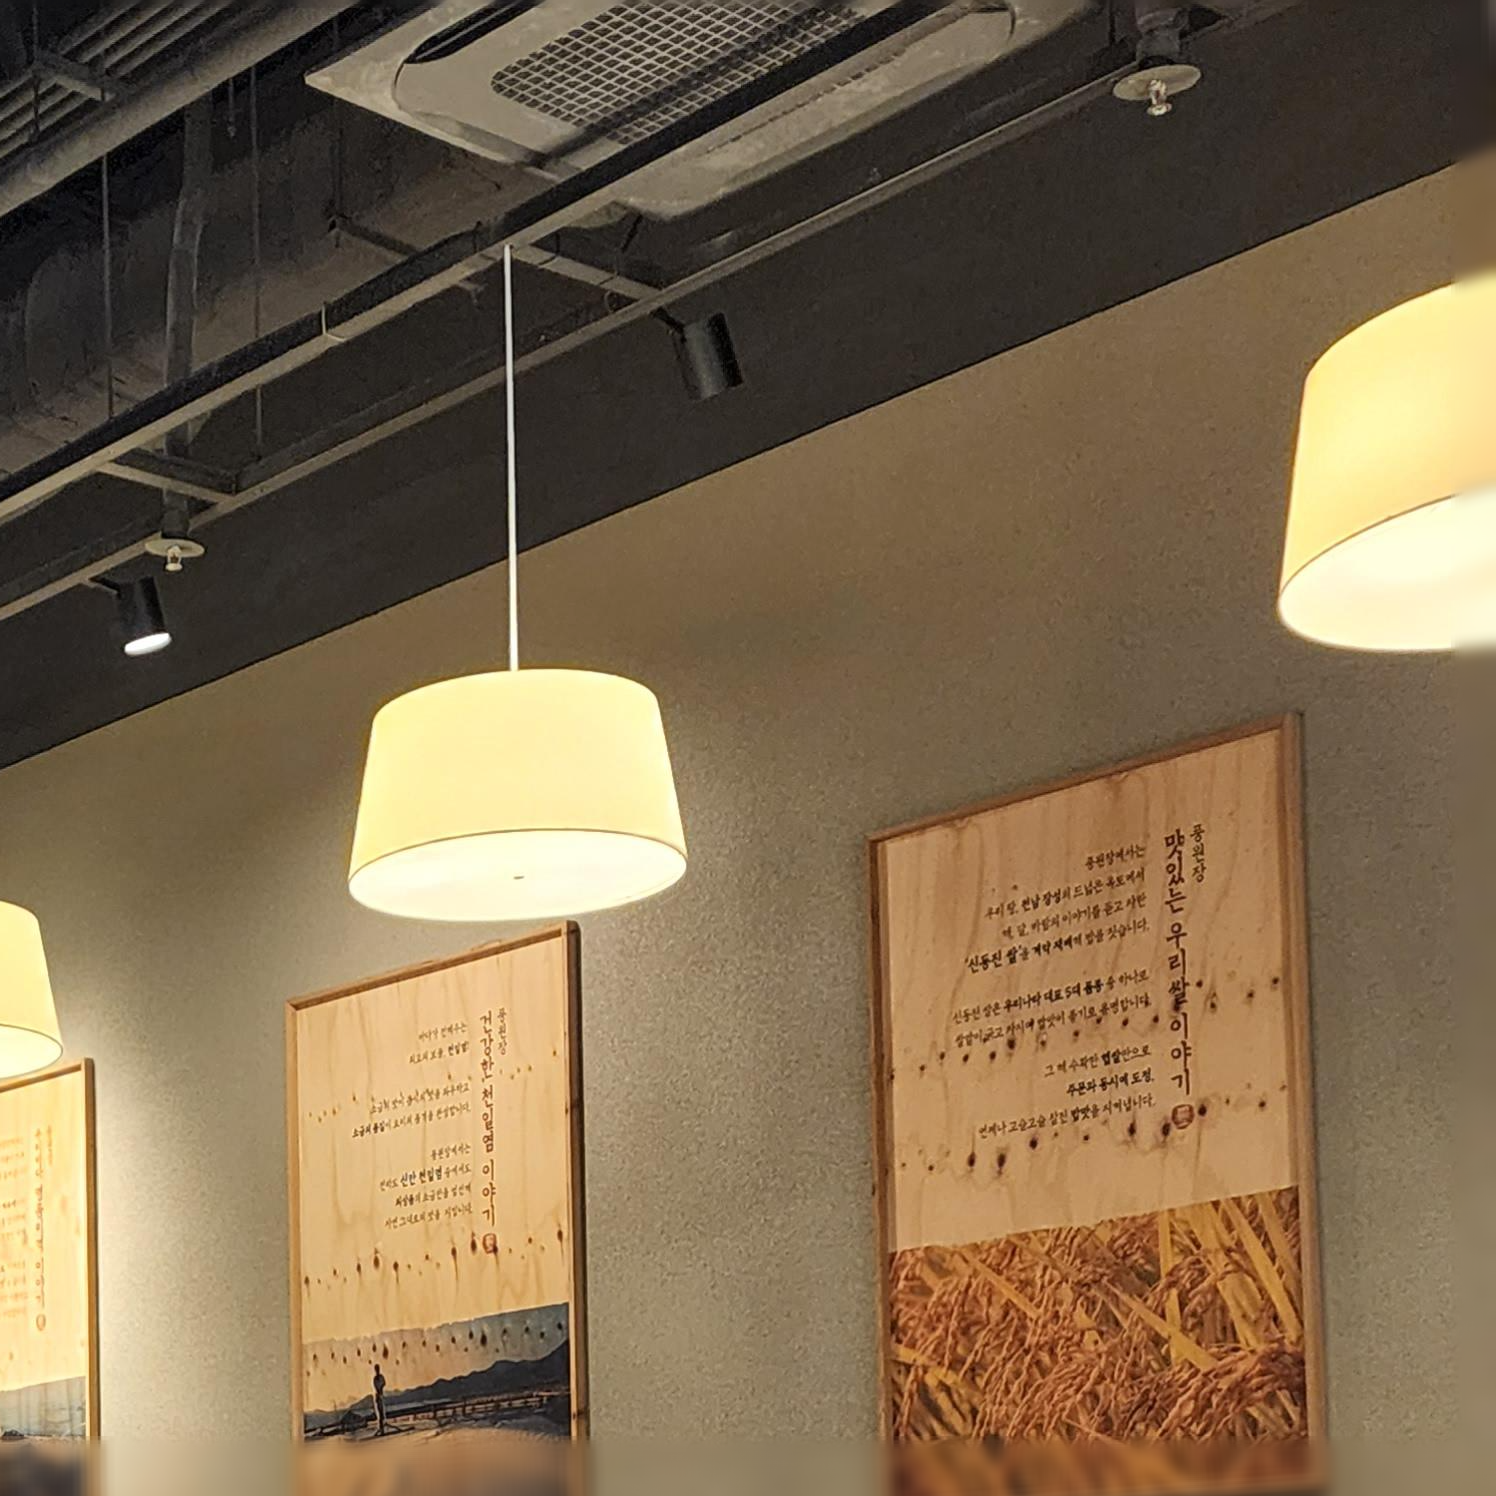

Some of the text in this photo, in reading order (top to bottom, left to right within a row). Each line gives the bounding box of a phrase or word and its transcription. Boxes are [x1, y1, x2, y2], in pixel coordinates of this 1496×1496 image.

[1164, 828, 1187, 914] 맛있는
[1190, 823, 1207, 884] 풍원장
[1004, 992, 1041, 1012] 우리나라
[1044, 989, 1063, 1002] 대표
[1065, 983, 1080, 999] 5대
[479, 1010, 495, 1079] 건강한
[1170, 1012, 1192, 1096] 이야기
[481, 1083, 494, 1153] 천일염
[482, 1158, 496, 1228] 이야기
